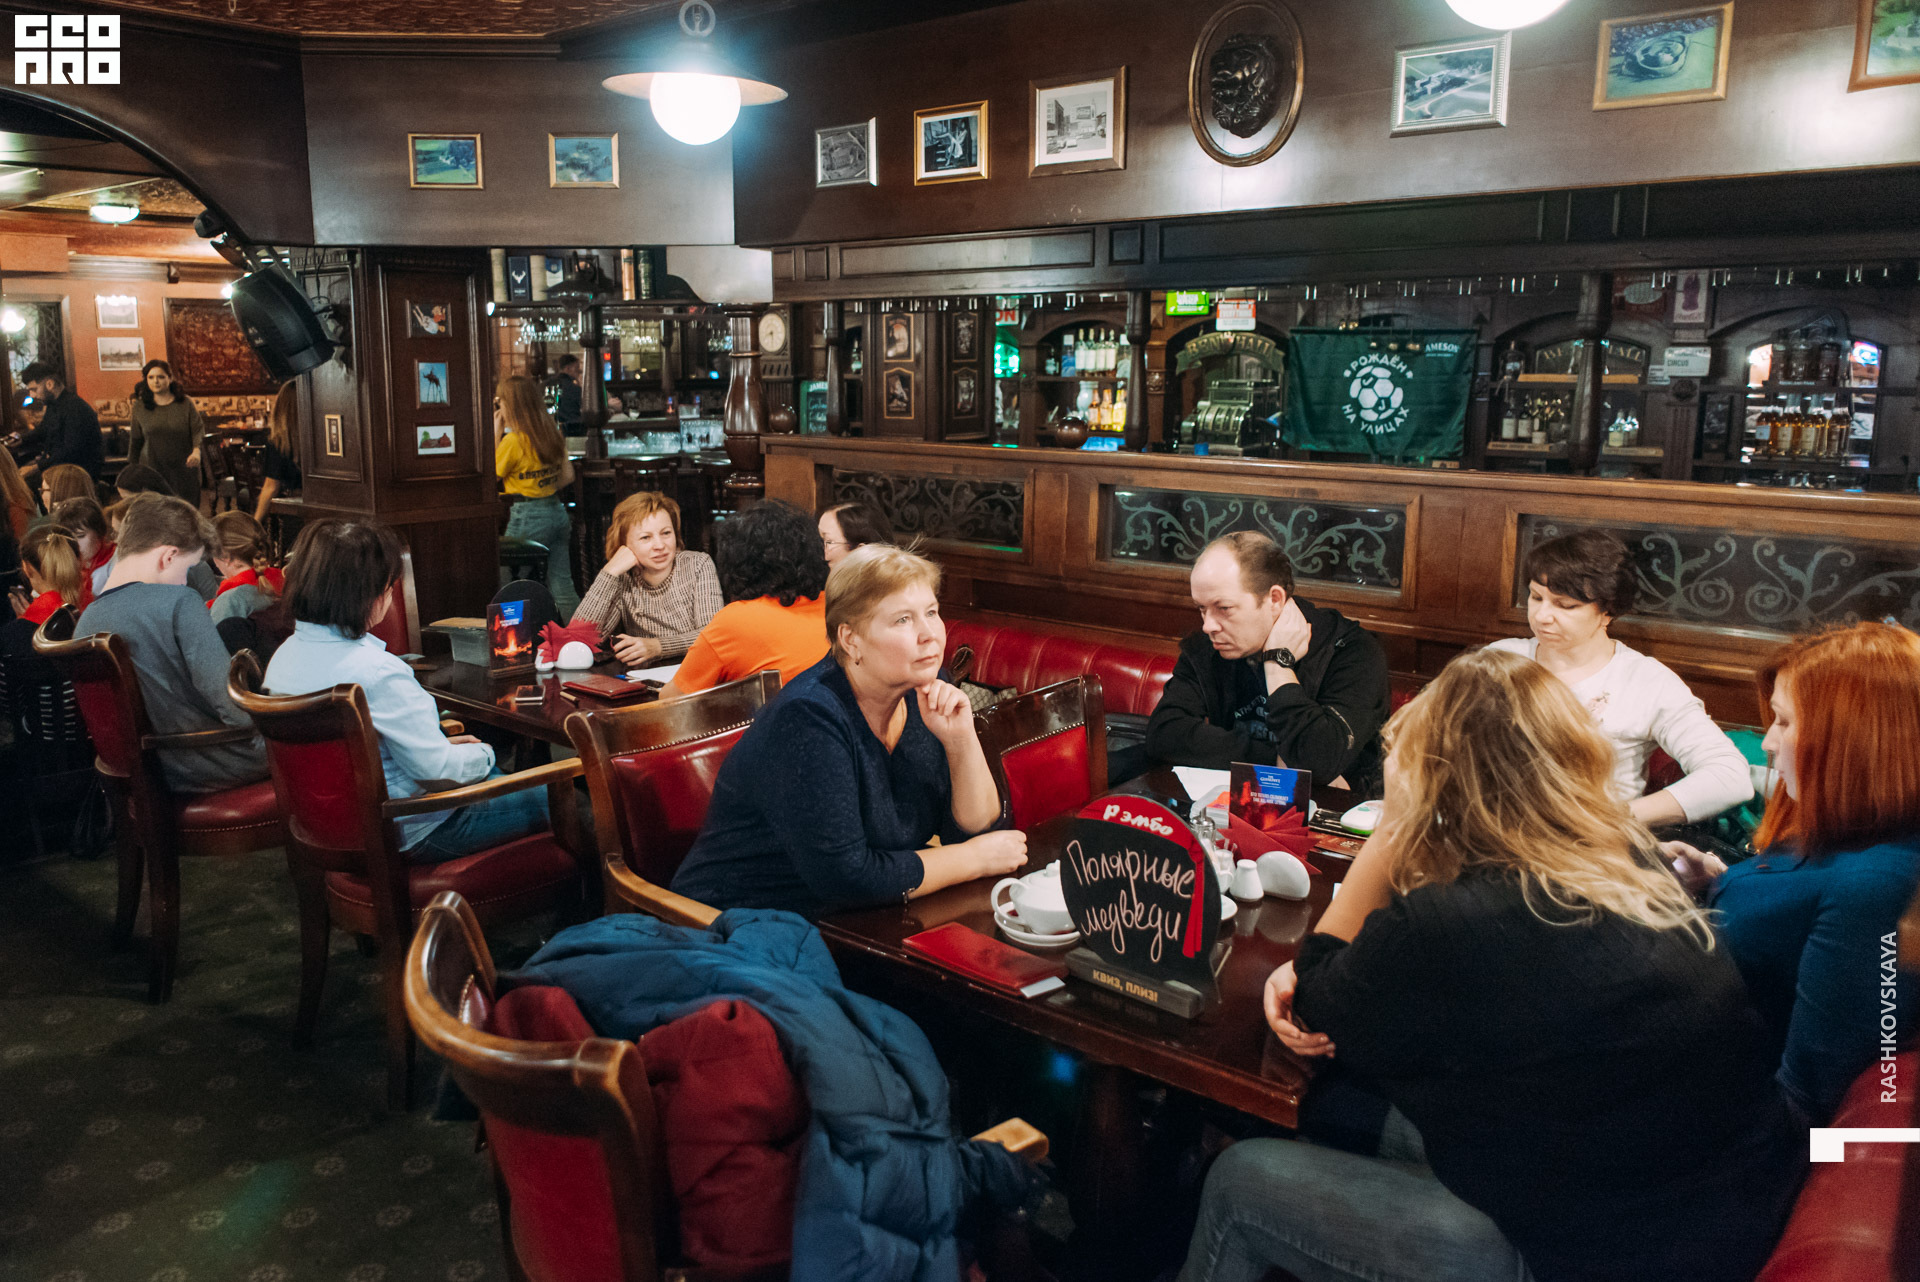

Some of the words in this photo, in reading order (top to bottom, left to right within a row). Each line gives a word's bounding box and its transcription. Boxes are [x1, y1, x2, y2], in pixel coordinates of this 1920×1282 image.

[1350, 352, 1408, 374] РОЖДЁН
[1341, 403, 1357, 424] НА
[1360, 405, 1410, 435] УЛИЦАХ
[1066, 839, 1195, 898] Полярные
[1125, 980, 1159, 1003] ПЛИЗ!
